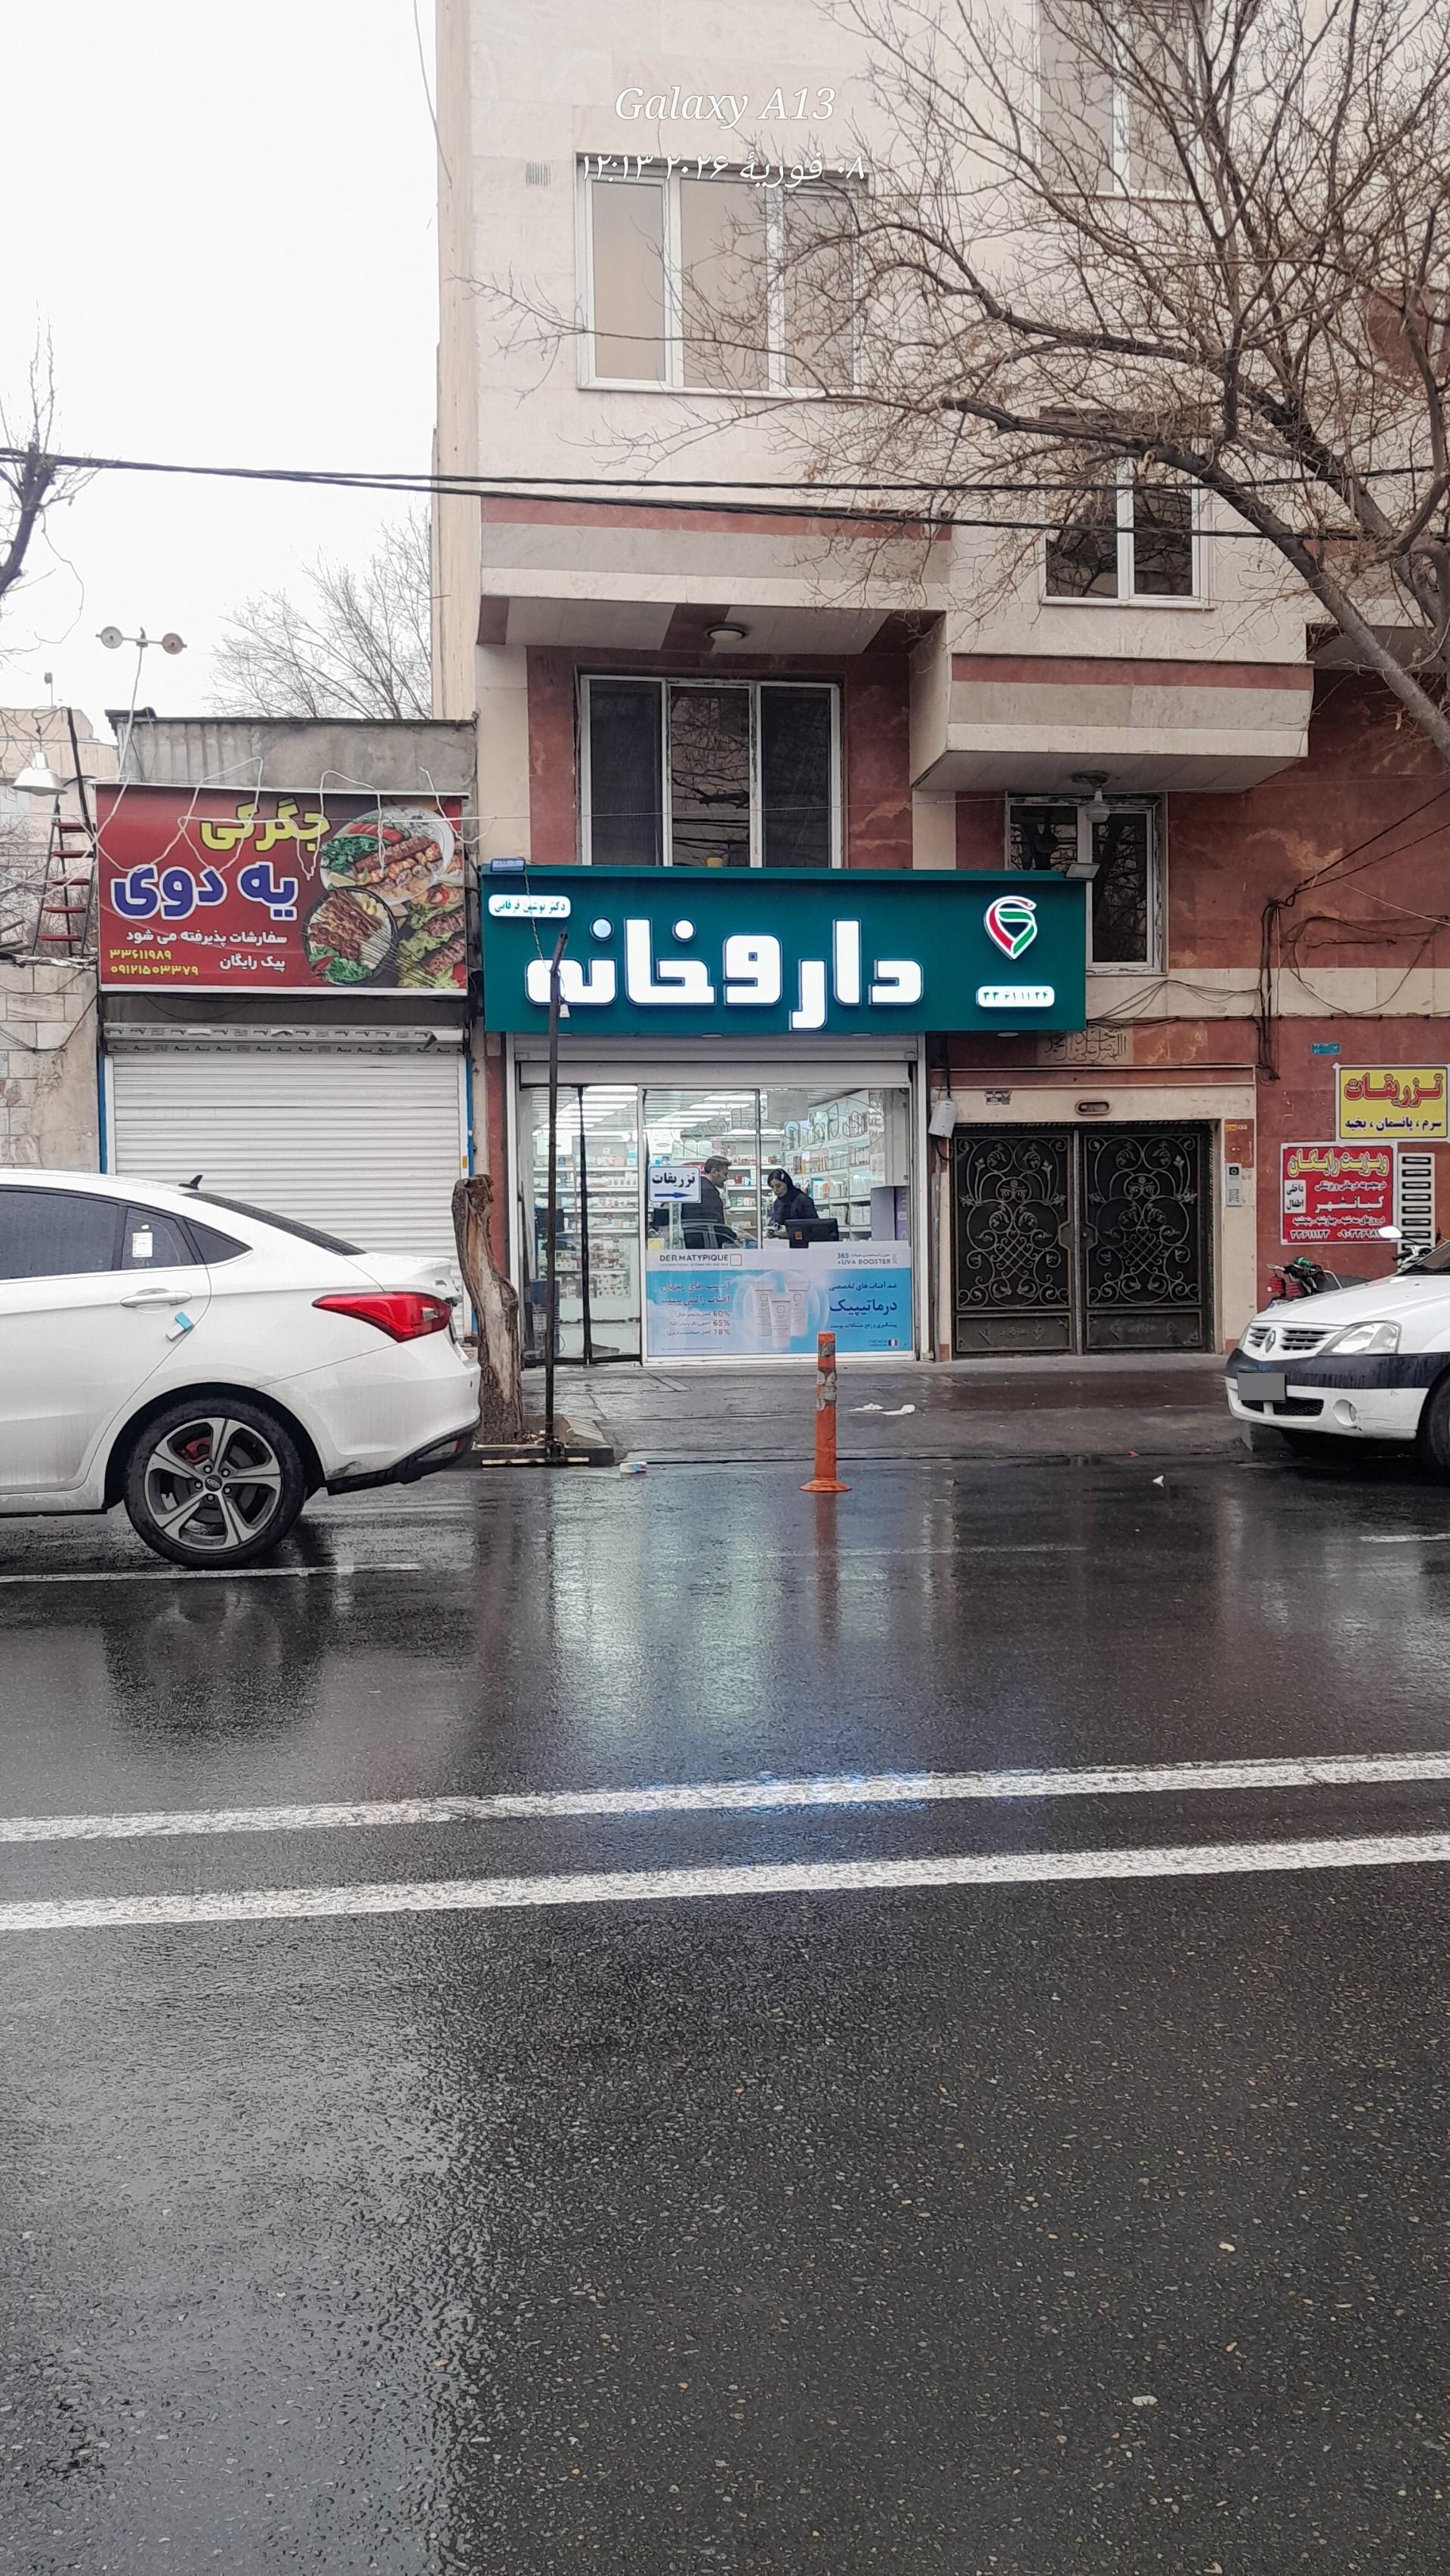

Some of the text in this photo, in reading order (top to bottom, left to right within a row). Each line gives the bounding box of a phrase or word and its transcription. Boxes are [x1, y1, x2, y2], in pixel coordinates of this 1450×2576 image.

[200, 797, 331, 852] جگرکی
[110, 861, 298, 921] یه دوی
[494, 899, 520, 913] فرقانی
[549, 901, 566, 915] دکتر
[126, 928, 288, 949] سفارشات پذیرفته می شود
[110, 949, 172, 961] ۳۳۶۱۱۹۸۹
[220, 953, 286, 972] پیک رایگان
[110, 964, 199, 976] ۰۹۱۲۱۵۰۳۳۷۹
[524, 916, 925, 1032] داروخانه
[1344, 1072, 1443, 1108] تزریقات
[1345, 1117, 1366, 1131] بخیه
[1376, 1117, 1413, 1131] پانسمان
[1422, 1119, 1442, 1131] سرم
[1287, 1148, 1389, 1177] ویزیت رایگان
[652, 1172, 696, 1188] تزریقات
[1287, 1199, 1304, 1210] اطفال
[1315, 1195, 1384, 1214] کیانشهر
[659, 1254, 730, 1262] DERMATYPIQUE
[829, 1298, 898, 1316] درماتیپیک
